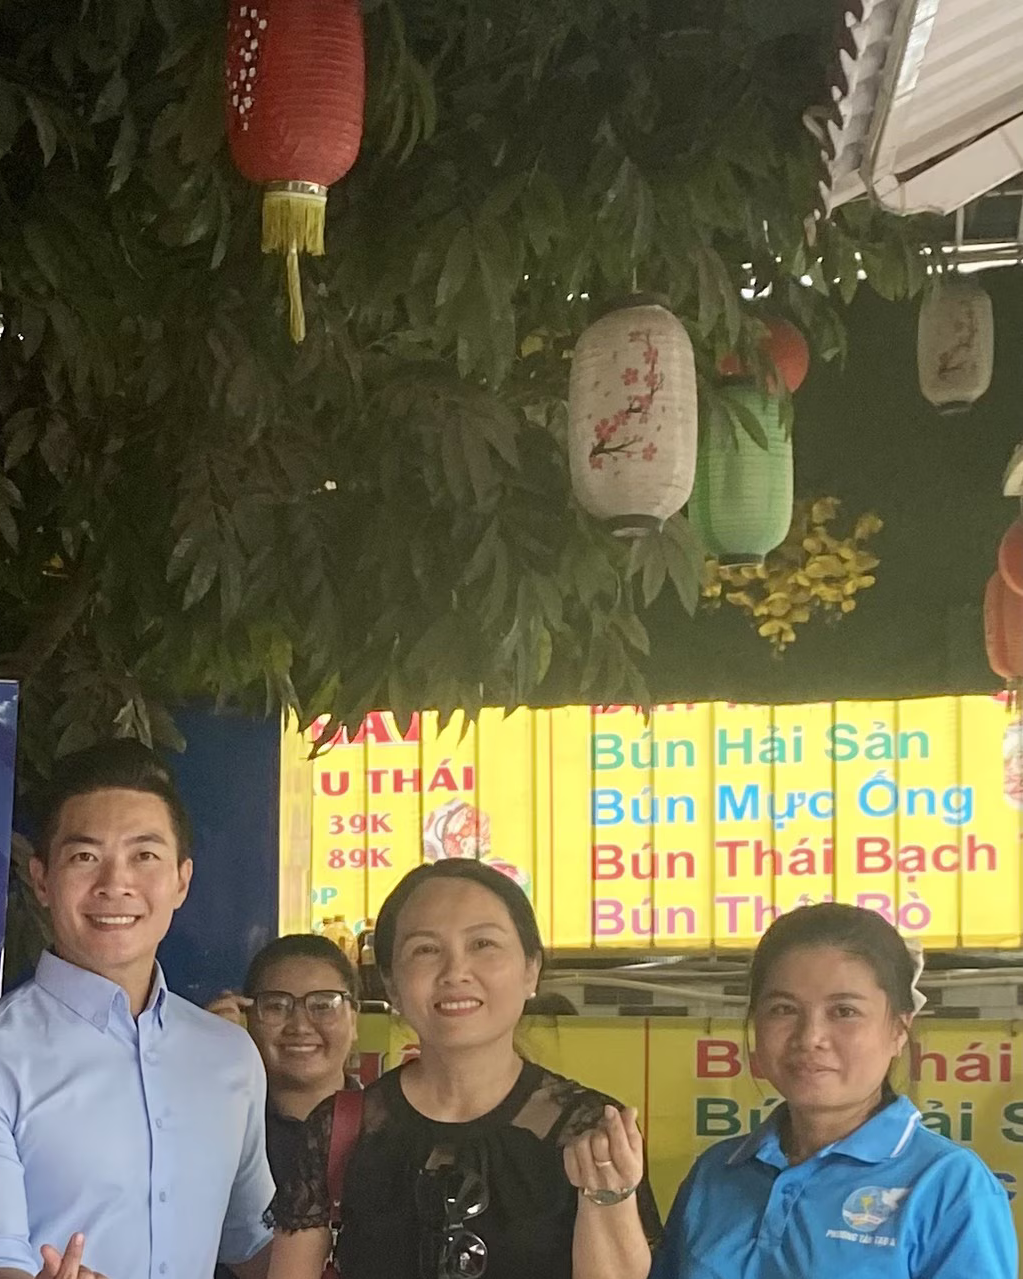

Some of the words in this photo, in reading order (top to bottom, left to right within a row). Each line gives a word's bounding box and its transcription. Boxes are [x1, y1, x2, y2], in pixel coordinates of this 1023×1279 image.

[591, 731, 695, 769] Bún
[718, 724, 802, 765] Hải
[824, 721, 929, 761] Sản
[314, 772, 349, 796] U
[367, 758, 474, 793] THÁI
[591, 787, 695, 825] Bún
[718, 784, 836, 829] Mực
[858, 770, 973, 825] Ống
[329, 813, 393, 835] 39K
[327, 848, 393, 868] 89K
[591, 843, 695, 880] Bún
[715, 838, 834, 877] Thái
[856, 834, 997, 882] Bạch
[591, 897, 695, 934] Bún
[715, 893, 834, 933] Th
[911, 1042, 1011, 1082] hái
[921, 1100, 972, 1141] ải
